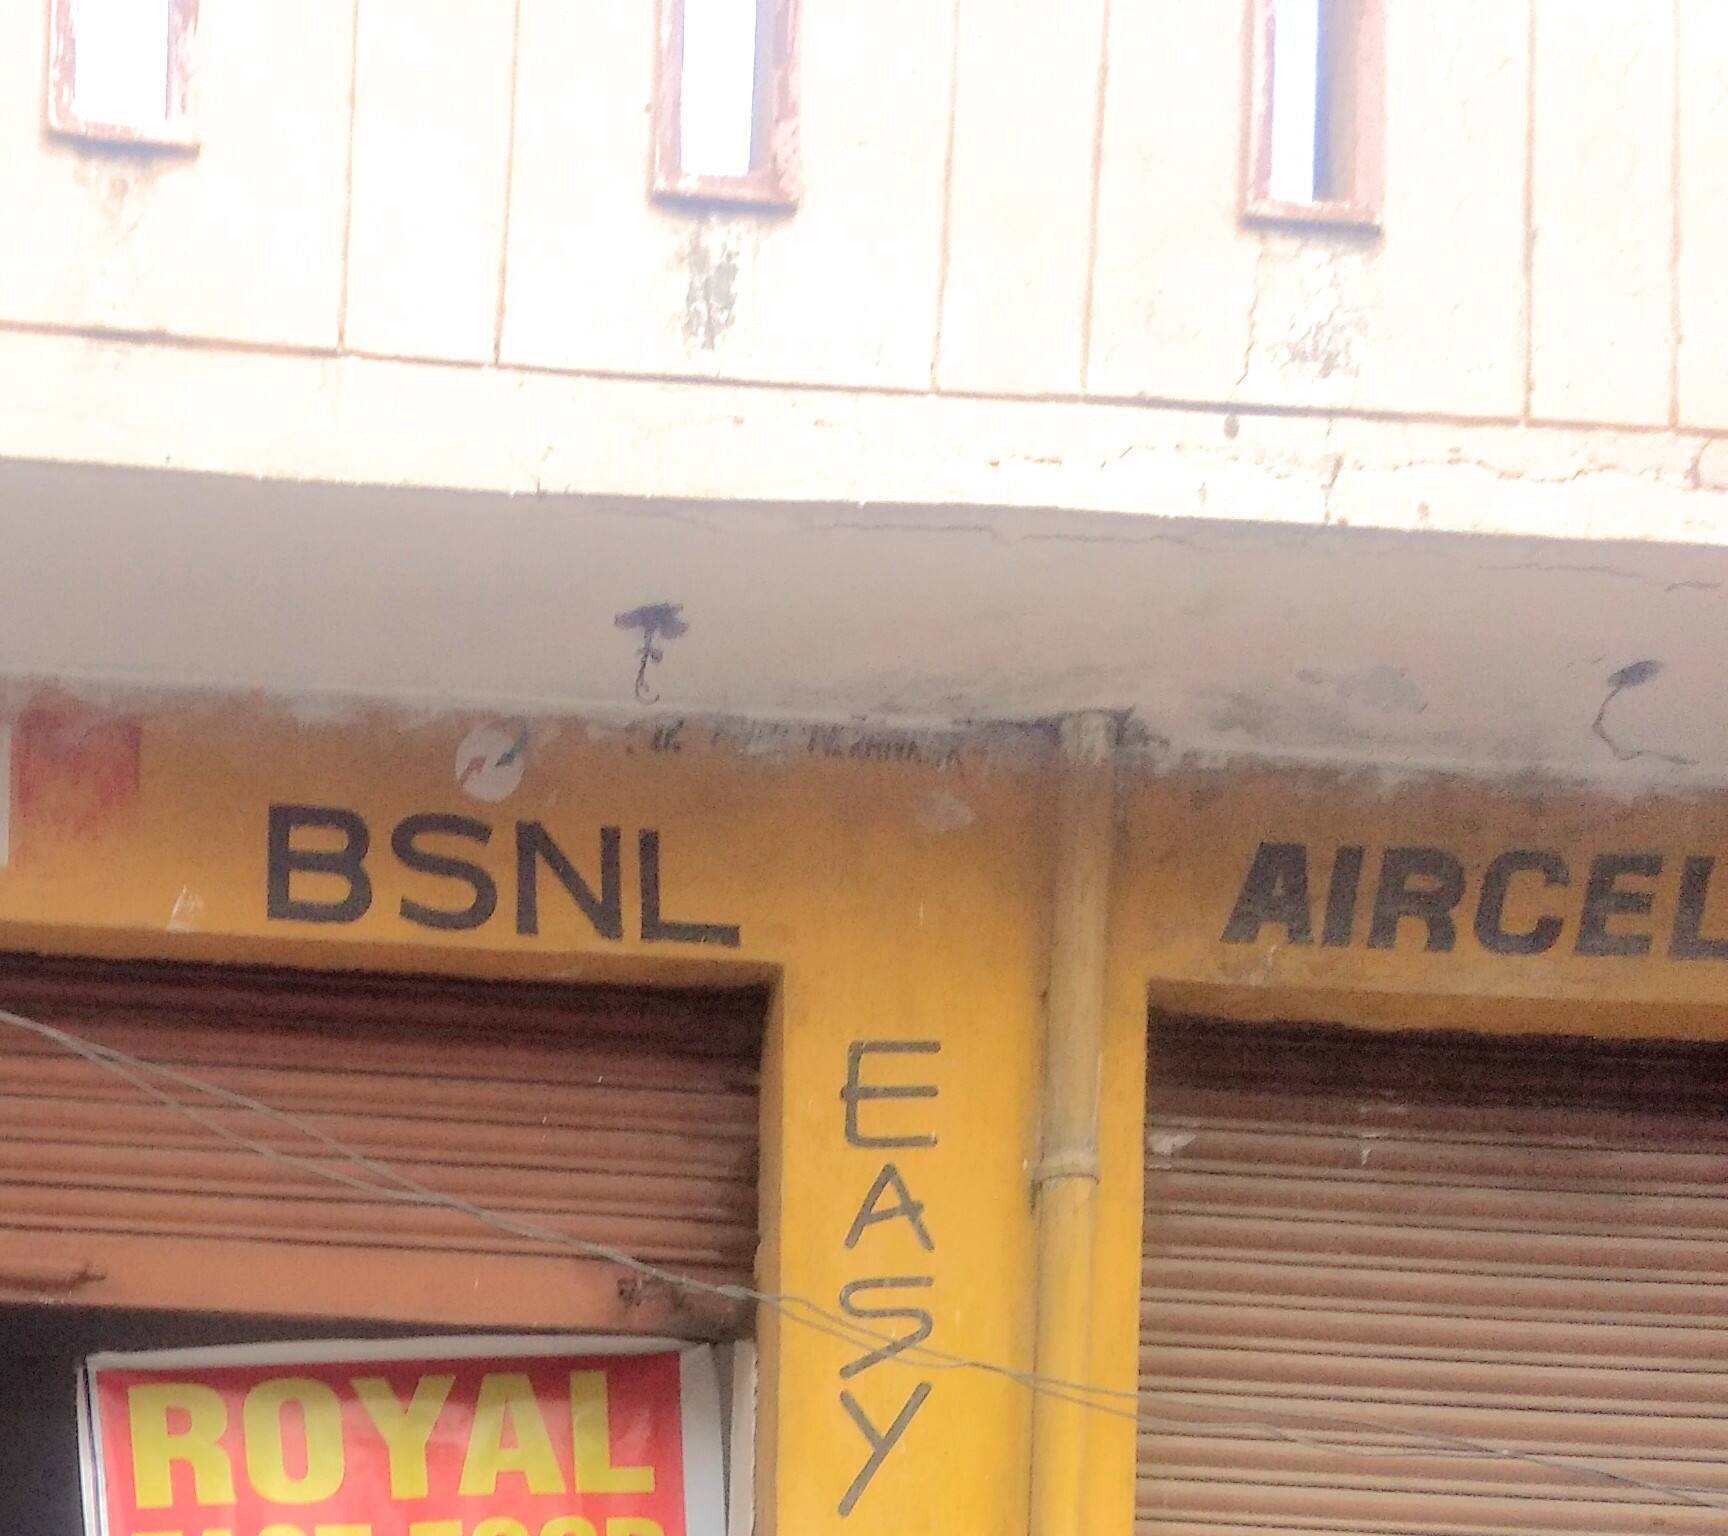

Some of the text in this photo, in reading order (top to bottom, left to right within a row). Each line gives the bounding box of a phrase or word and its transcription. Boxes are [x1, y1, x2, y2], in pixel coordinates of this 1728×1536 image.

[267, 805, 741, 949] BSNL
[1220, 841, 1728, 959] AIRCEL
[839, 1040, 941, 1518] EASY
[127, 1370, 656, 1511] ROYAL
